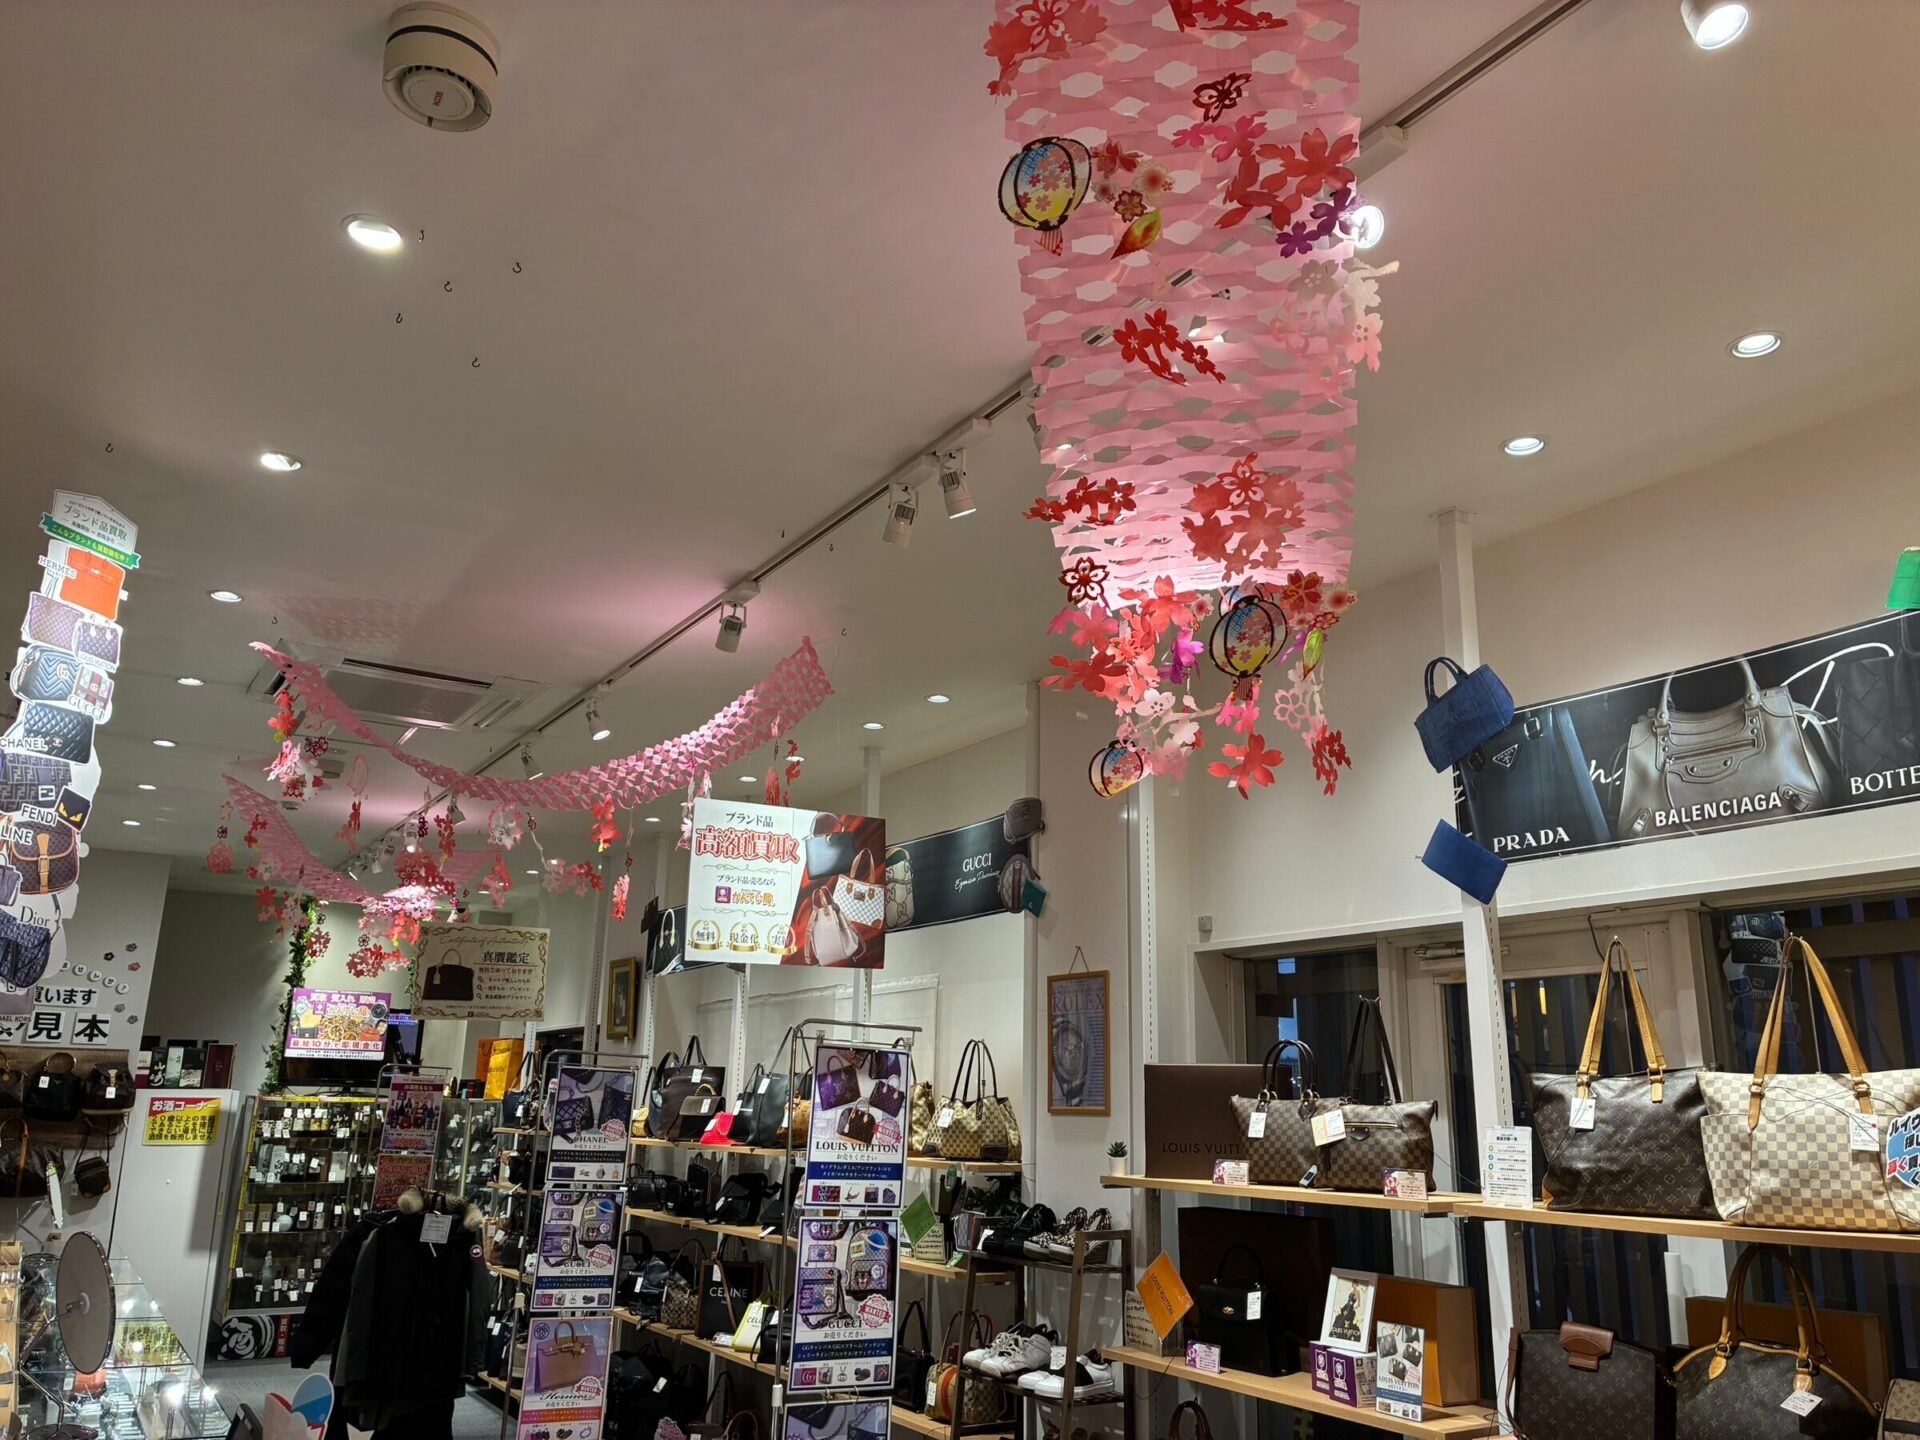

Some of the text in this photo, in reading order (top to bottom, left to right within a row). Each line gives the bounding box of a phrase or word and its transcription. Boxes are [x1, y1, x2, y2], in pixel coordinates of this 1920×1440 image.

[63, 504, 127, 541] ブランド品買取
[68, 695, 105, 720] GUCCI
[0, 738, 47, 749] CHANEL
[1850, 765, 1920, 796] BOTTE
[21, 805, 58, 825] FENDI
[1655, 792, 1782, 828] BALENCIAGA
[726, 812, 774, 828] ブランド品
[1, 825, 32, 844] LINE
[695, 824, 801, 864] 高額買取
[1493, 827, 1570, 852] PRADA
[963, 852, 993, 872] GUCCI
[20, 906, 50, 927] Dior
[696, 930, 716, 942] 無料
[729, 932, 760, 944] 現金化
[482, 951, 530, 964] 真贋鑑定
[1053, 992, 1105, 1013] ROLEX
[151, 1100, 218, 1111] お酒コーナー
[815, 1141, 899, 1153] LOUIS VUITTON
[1162, 1142, 1200, 1154] LOUIS
[709, 1286, 748, 1298] CEINE
[828, 1319, 863, 1329] GUCCI
